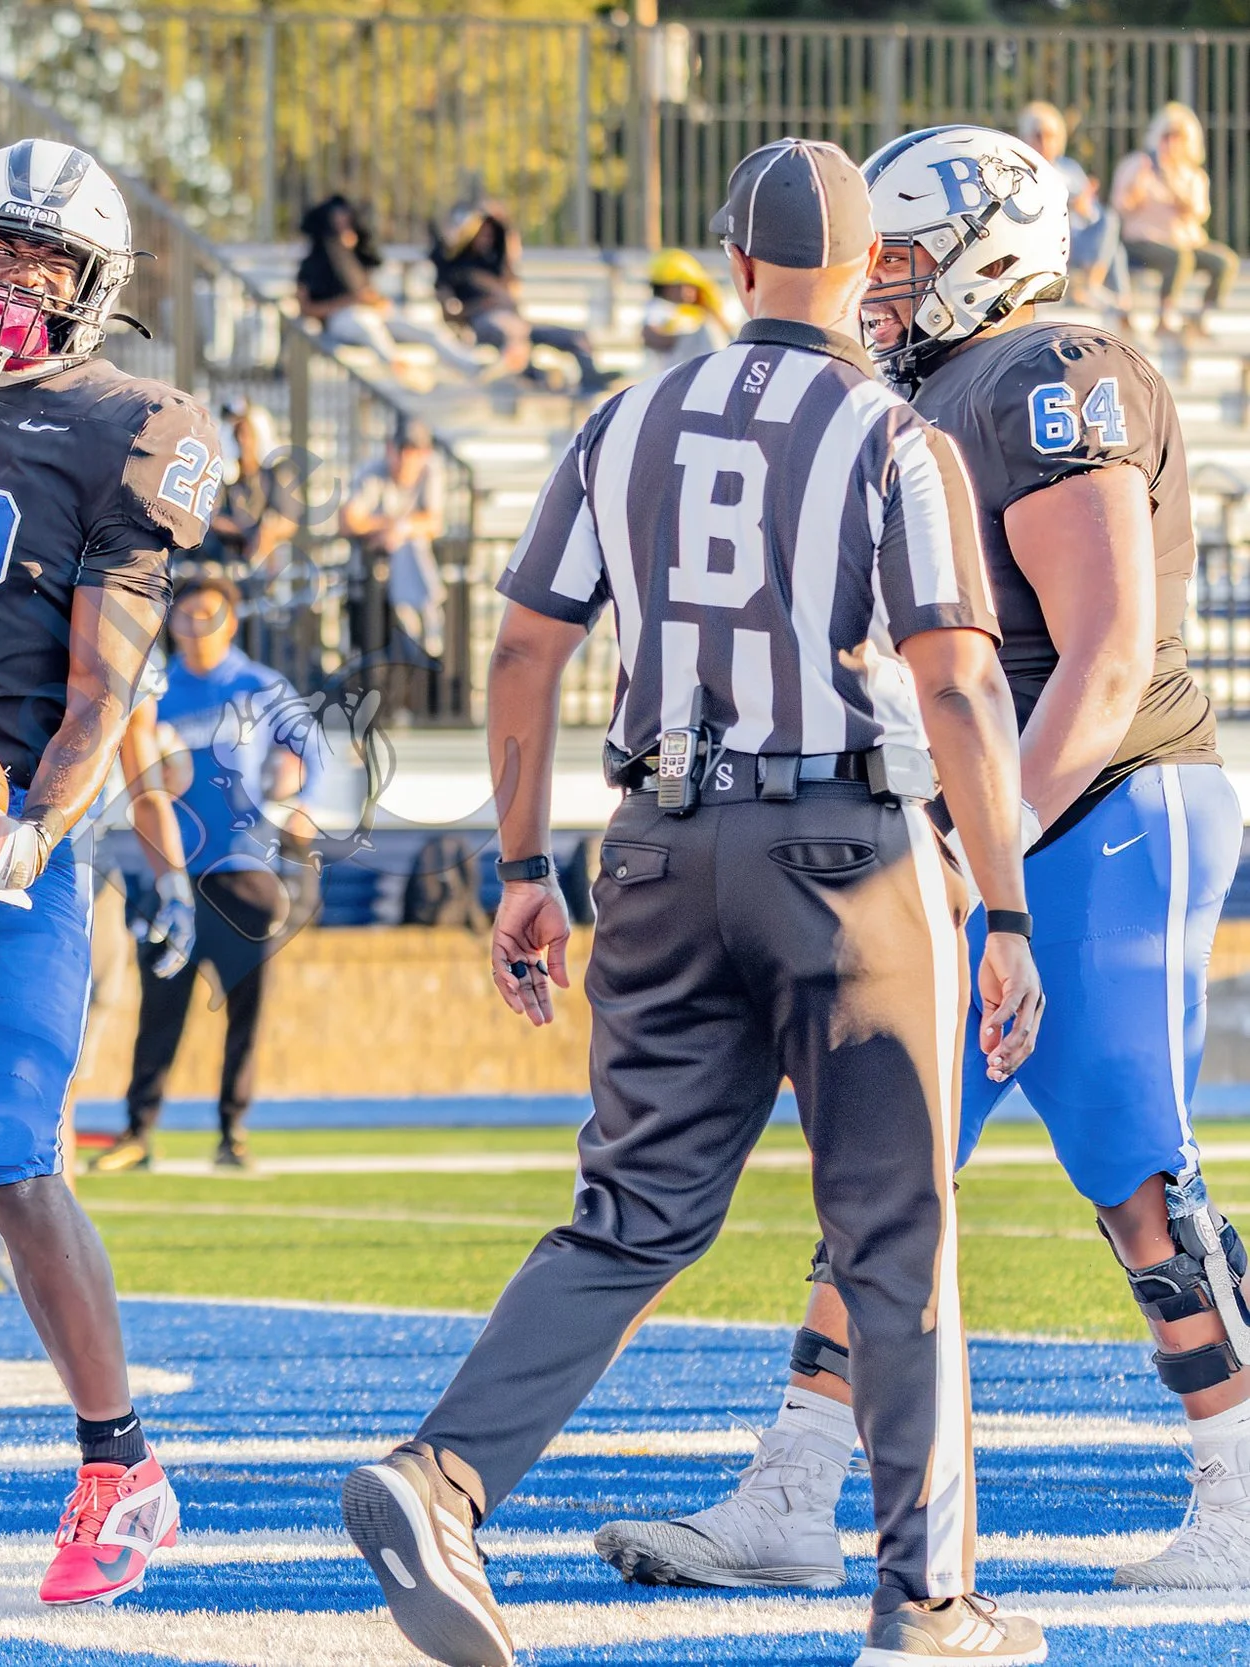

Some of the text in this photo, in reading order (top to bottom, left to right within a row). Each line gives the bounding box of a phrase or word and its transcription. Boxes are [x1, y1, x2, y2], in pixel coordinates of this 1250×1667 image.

[5, 202, 58, 224] Riddell
[742, 384, 762, 394] USA
[1028, 377, 1129, 455] 64
[157, 436, 224, 523] 22
[668, 431, 769, 609] B
[715, 763, 734, 791] S
